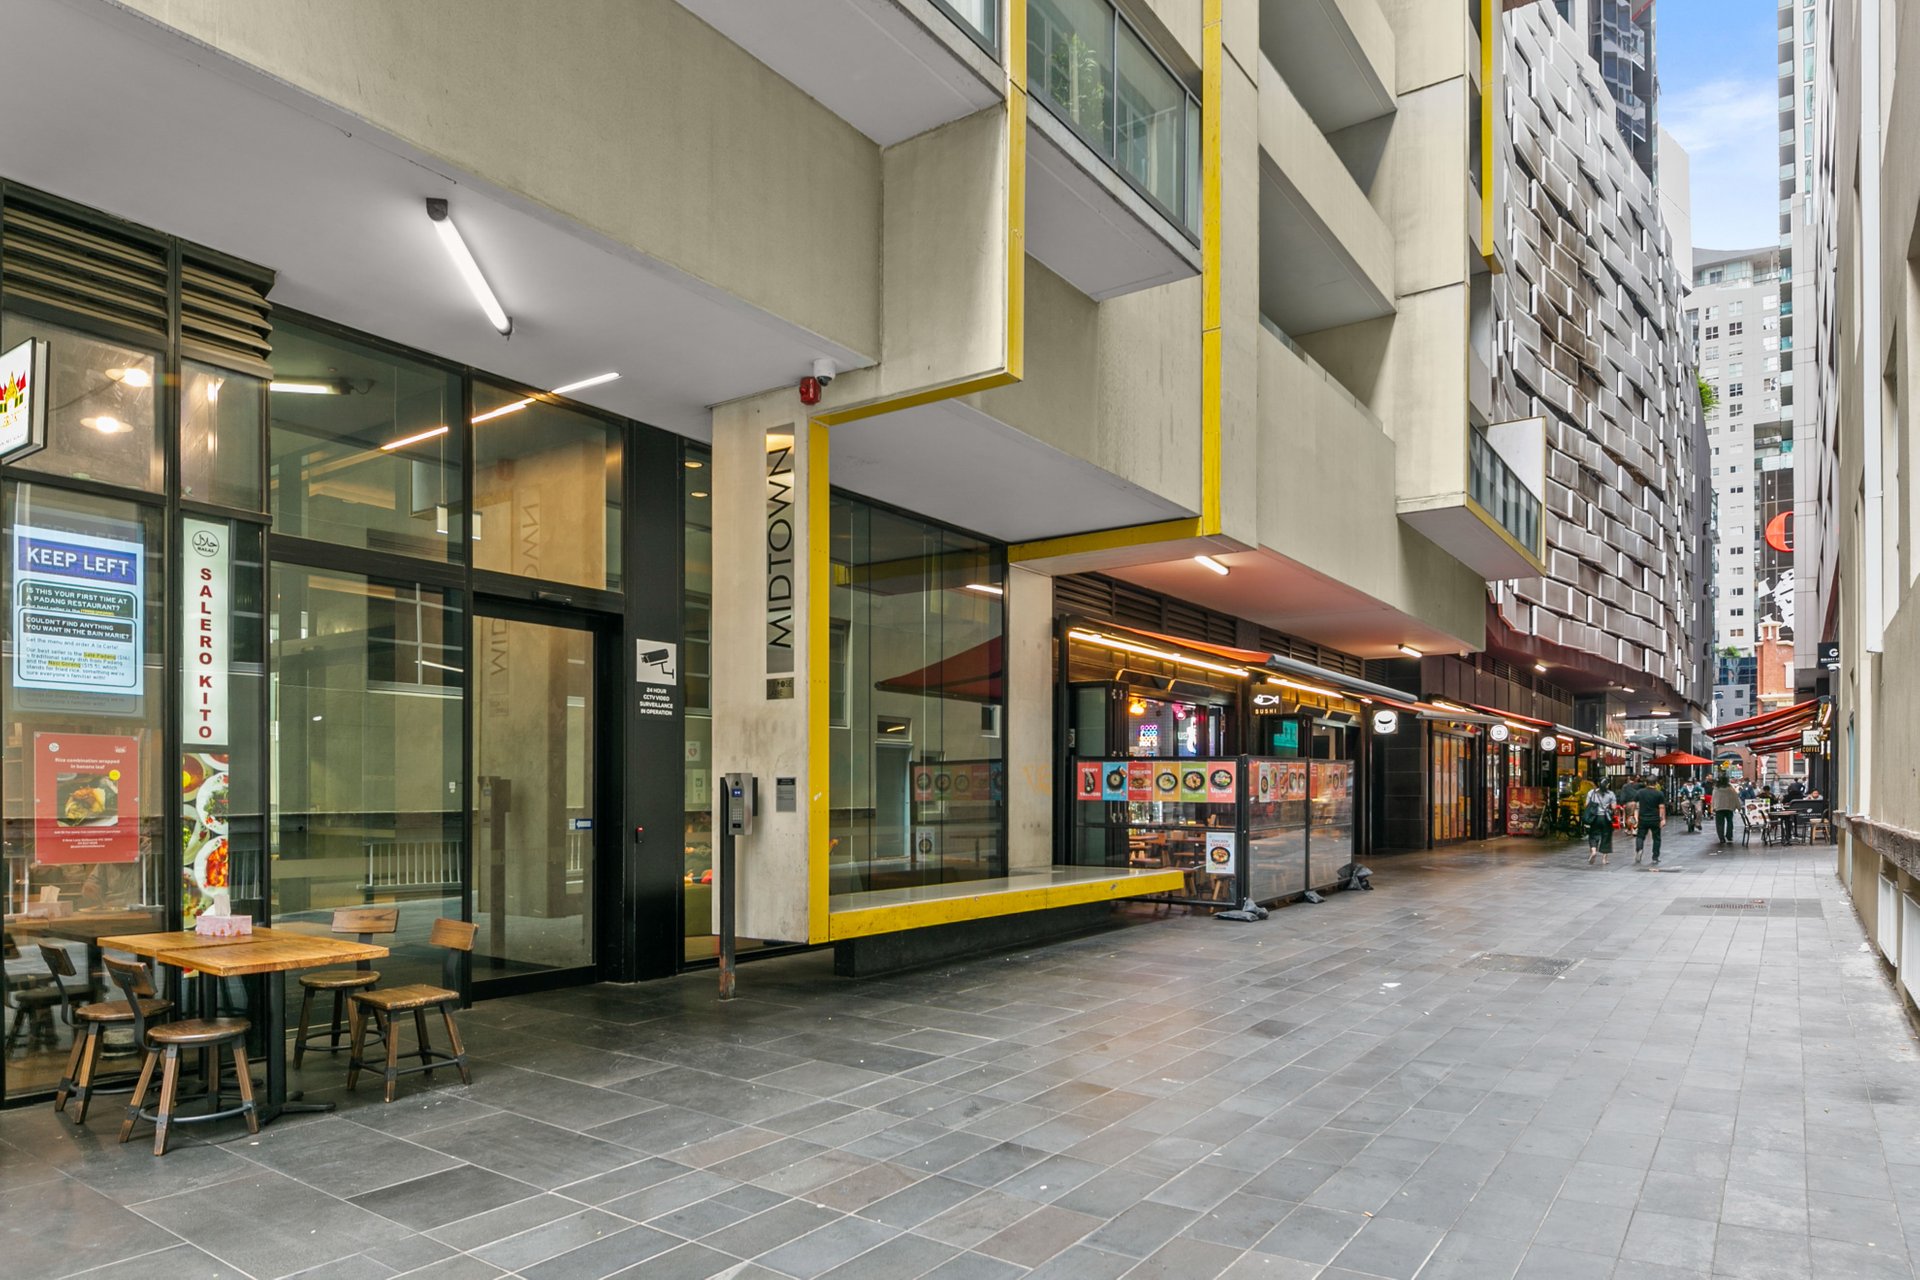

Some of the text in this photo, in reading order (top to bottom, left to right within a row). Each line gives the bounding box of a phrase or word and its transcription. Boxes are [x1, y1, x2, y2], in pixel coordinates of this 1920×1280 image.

[194, 534, 217, 547] حلال
[768, 446, 792, 648] MIDTOWN
[27, 546, 129, 575] KEEP LEFT
[34, 596, 66, 605] PADANG
[67, 600, 120, 610] RESTAURANT?
[54, 590, 75, 598] YOUR
[77, 592, 98, 601] FIRST
[100, 595, 116, 603] TIME
[26, 616, 60, 626] COULDN'T
[80, 622, 114, 631] ANYTHING
[199, 568, 212, 665] SALERO
[199, 675, 212, 738] KITO
[640, 701, 673, 709] SURVEILLANCE
